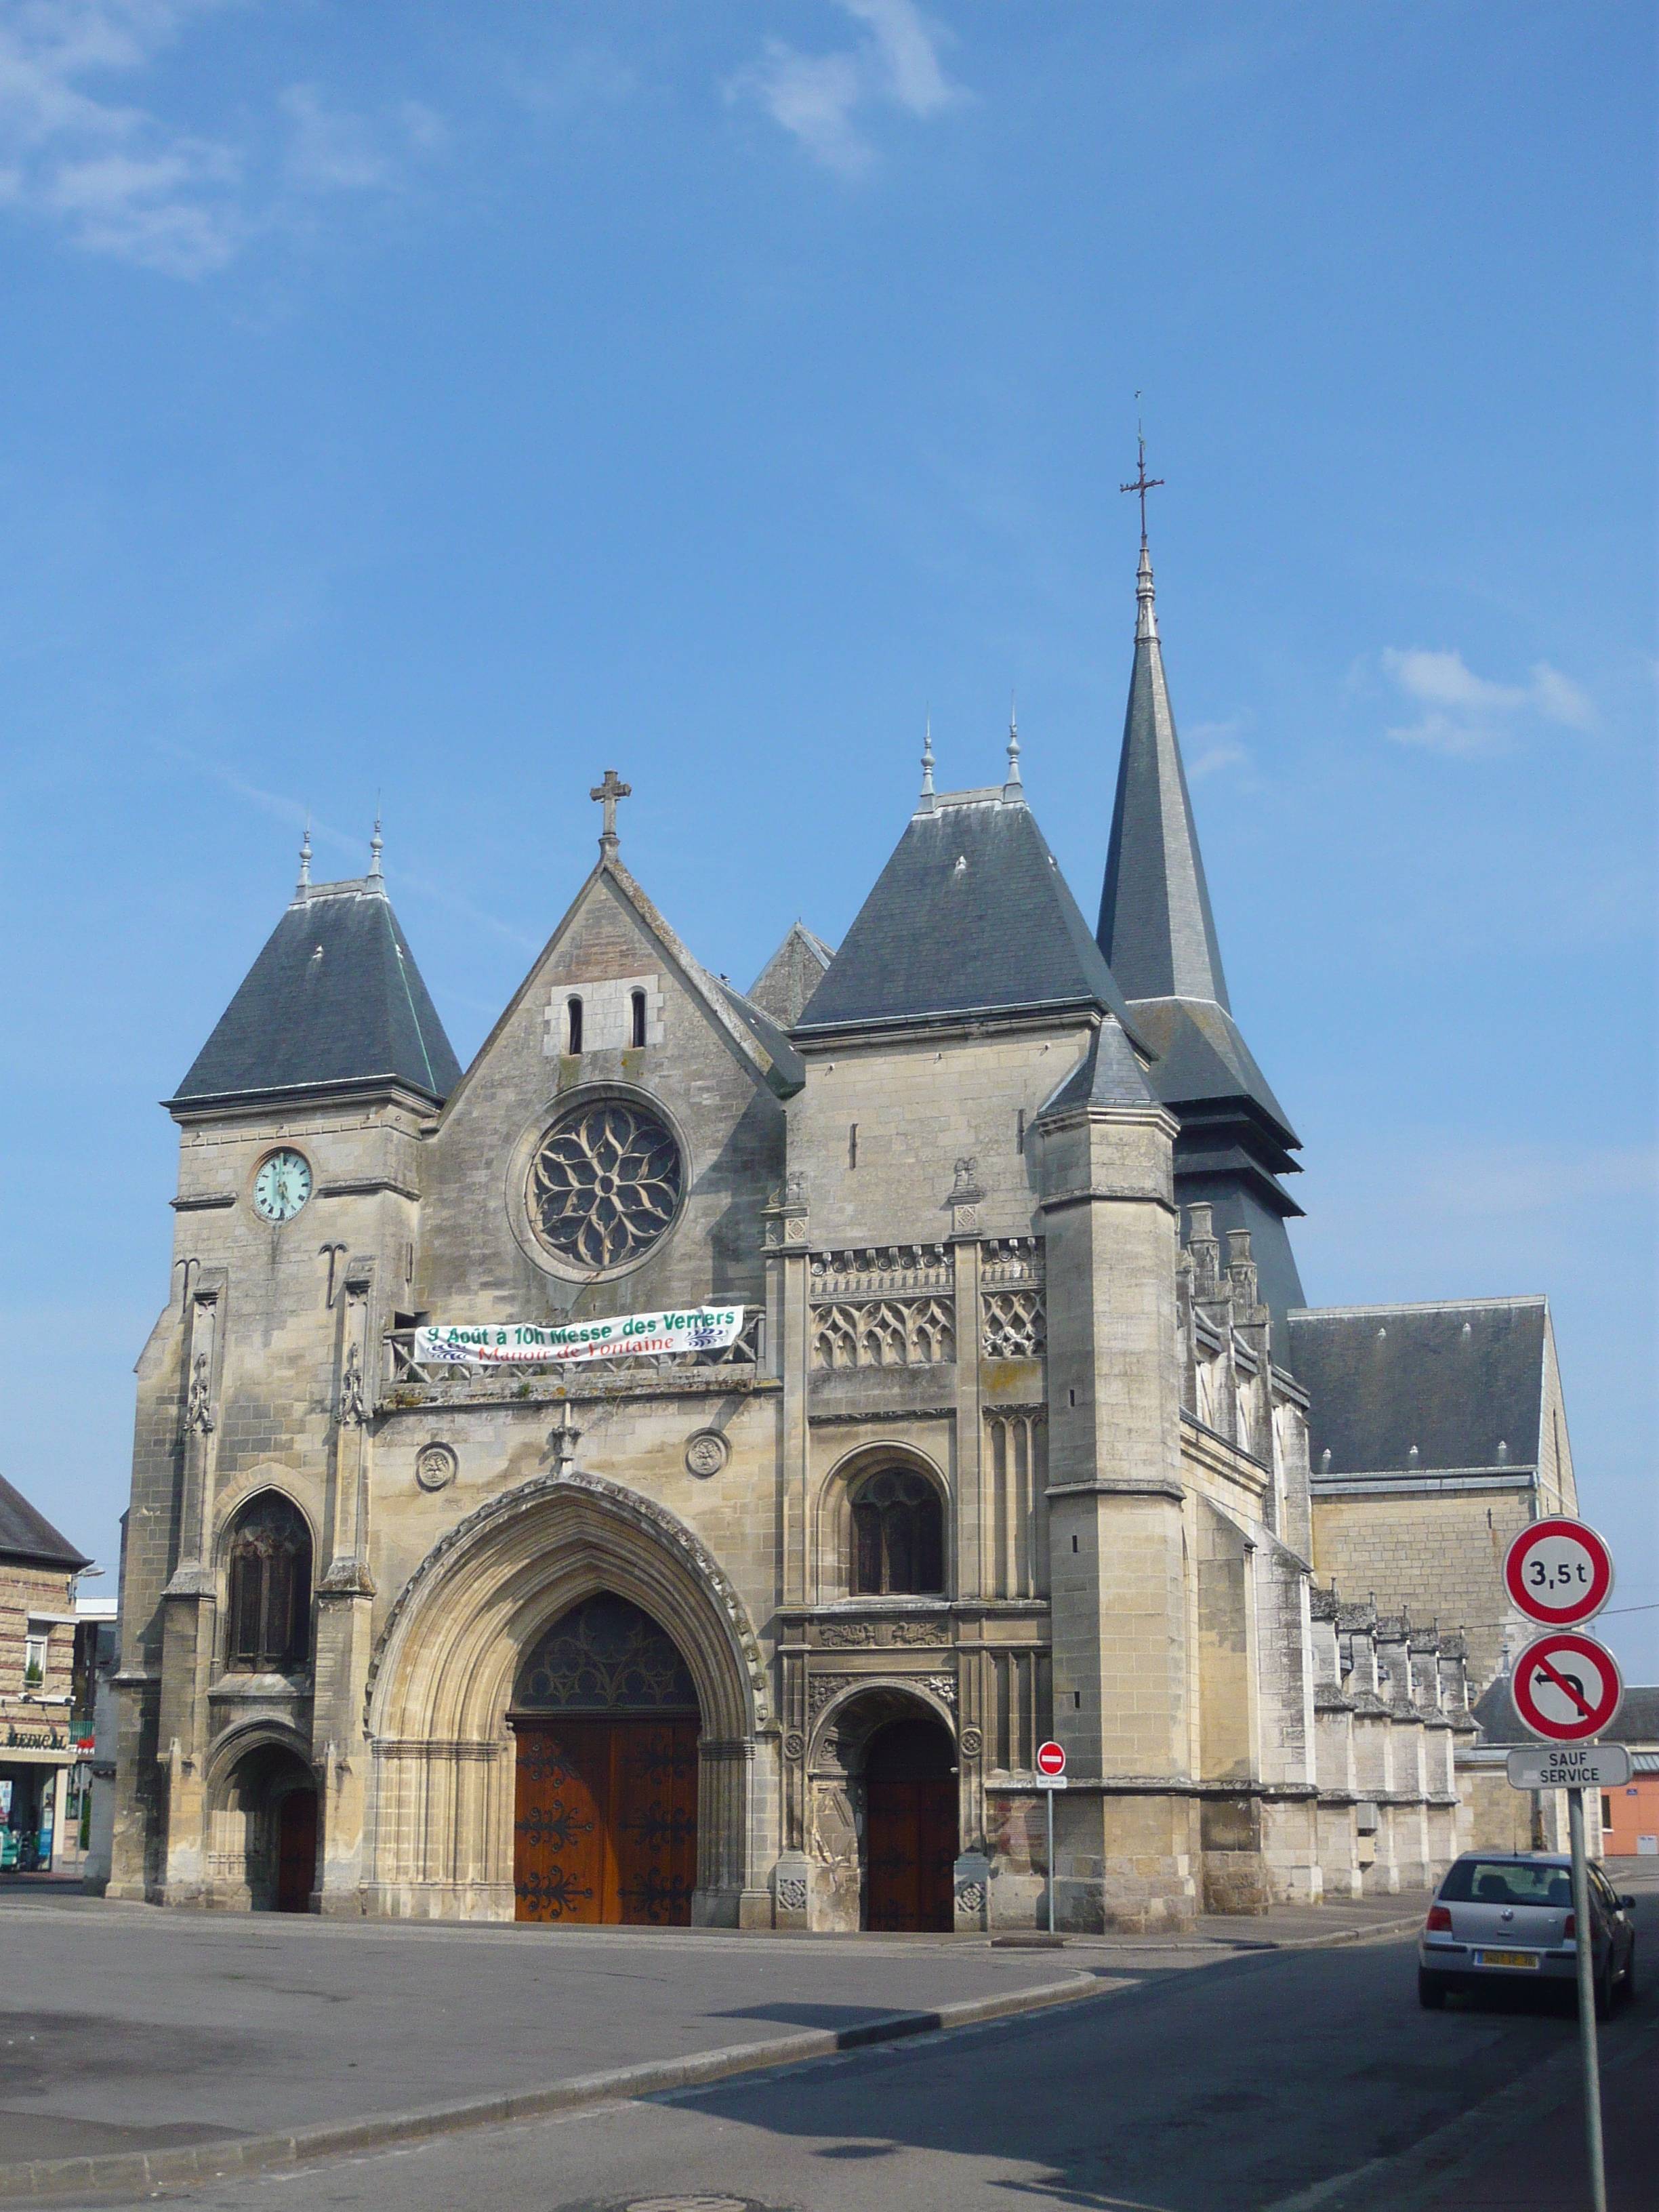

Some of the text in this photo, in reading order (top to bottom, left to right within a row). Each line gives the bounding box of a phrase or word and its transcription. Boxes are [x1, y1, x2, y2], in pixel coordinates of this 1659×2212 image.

[427, 1311, 735, 1345] 9 Août à 10h Messe des Verriers
[478, 1336, 674, 1361] Manoir de Fontaine
[1549, 1752, 1587, 1766] SAUF
[1540, 1767, 1600, 1784] SERVICE
